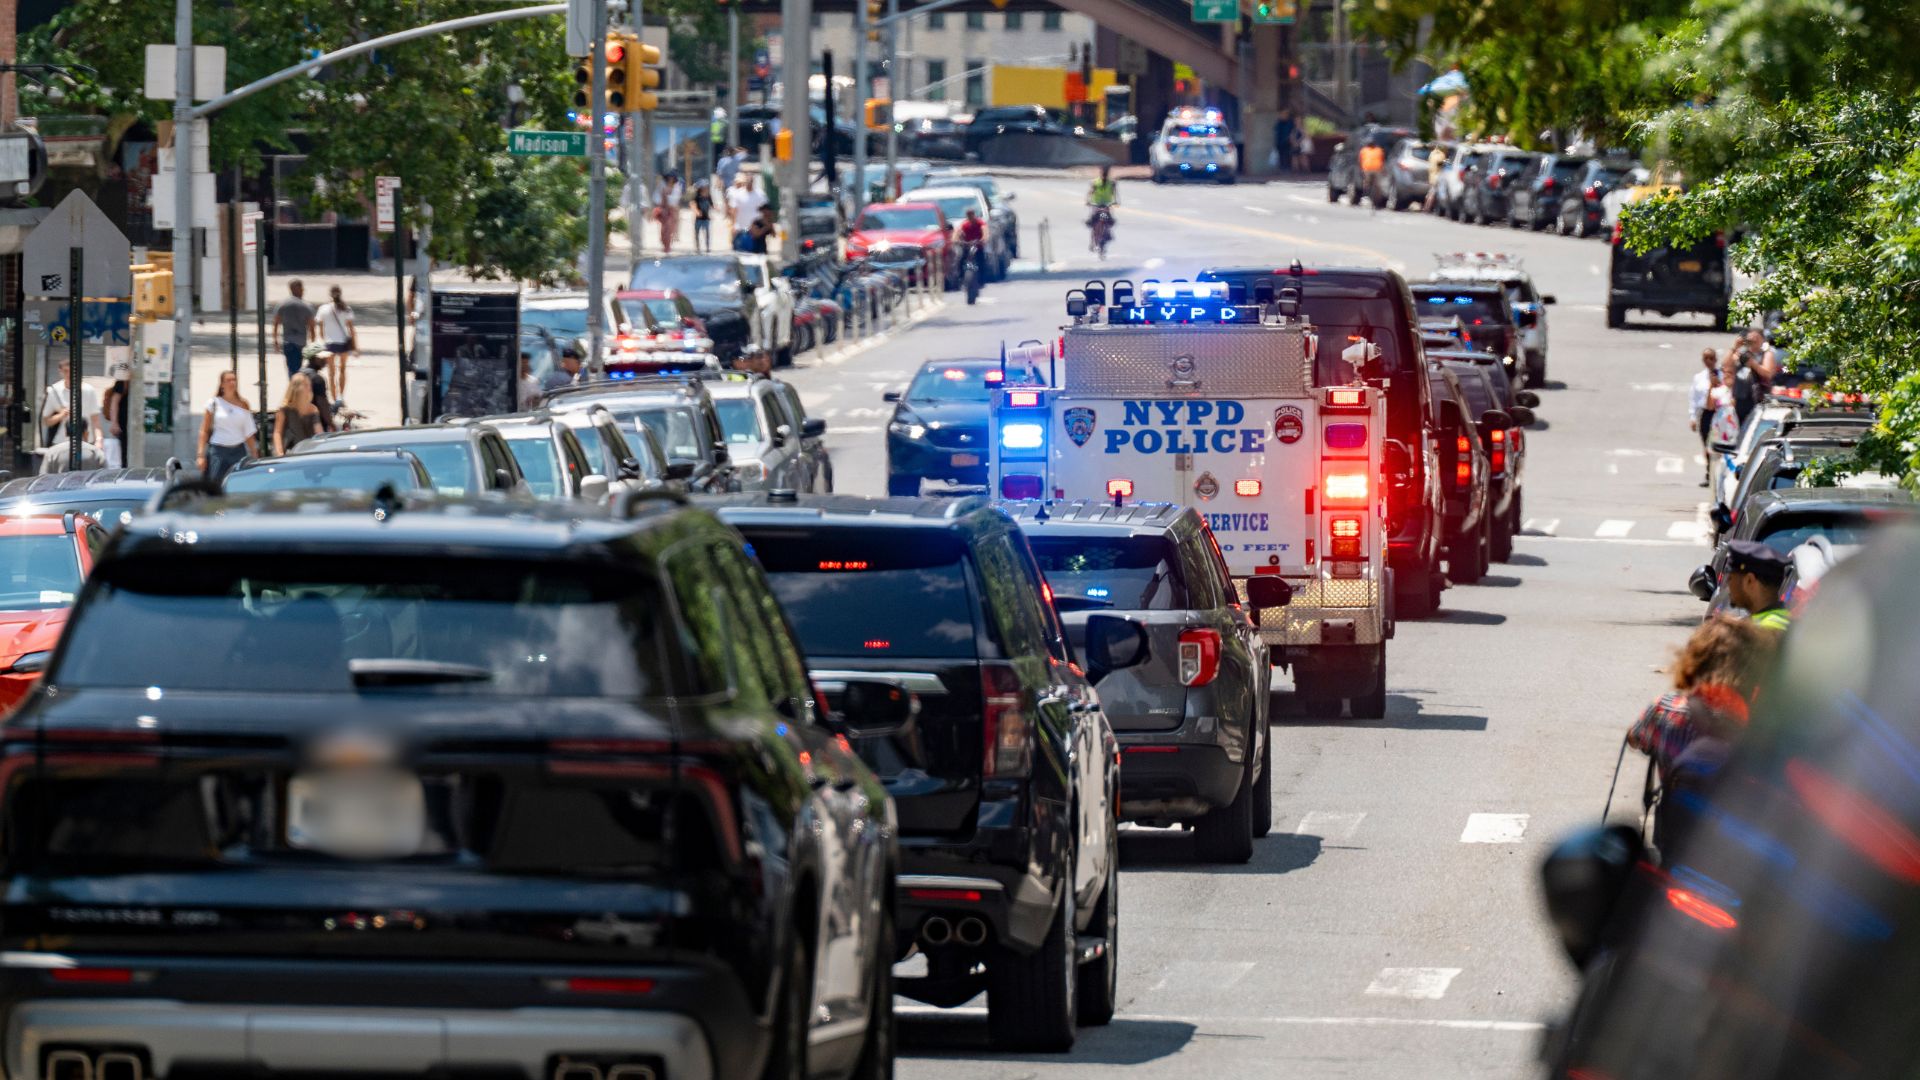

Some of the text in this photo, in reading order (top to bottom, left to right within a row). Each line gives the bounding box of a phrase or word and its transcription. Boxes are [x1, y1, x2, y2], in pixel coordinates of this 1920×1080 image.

[514, 134, 568, 153] Madison
[1123, 400, 1245, 426] NYPD
[1275, 406, 1302, 417] POLICE
[1104, 429, 1265, 454] POLICE
[1243, 543, 1290, 552] FEET
